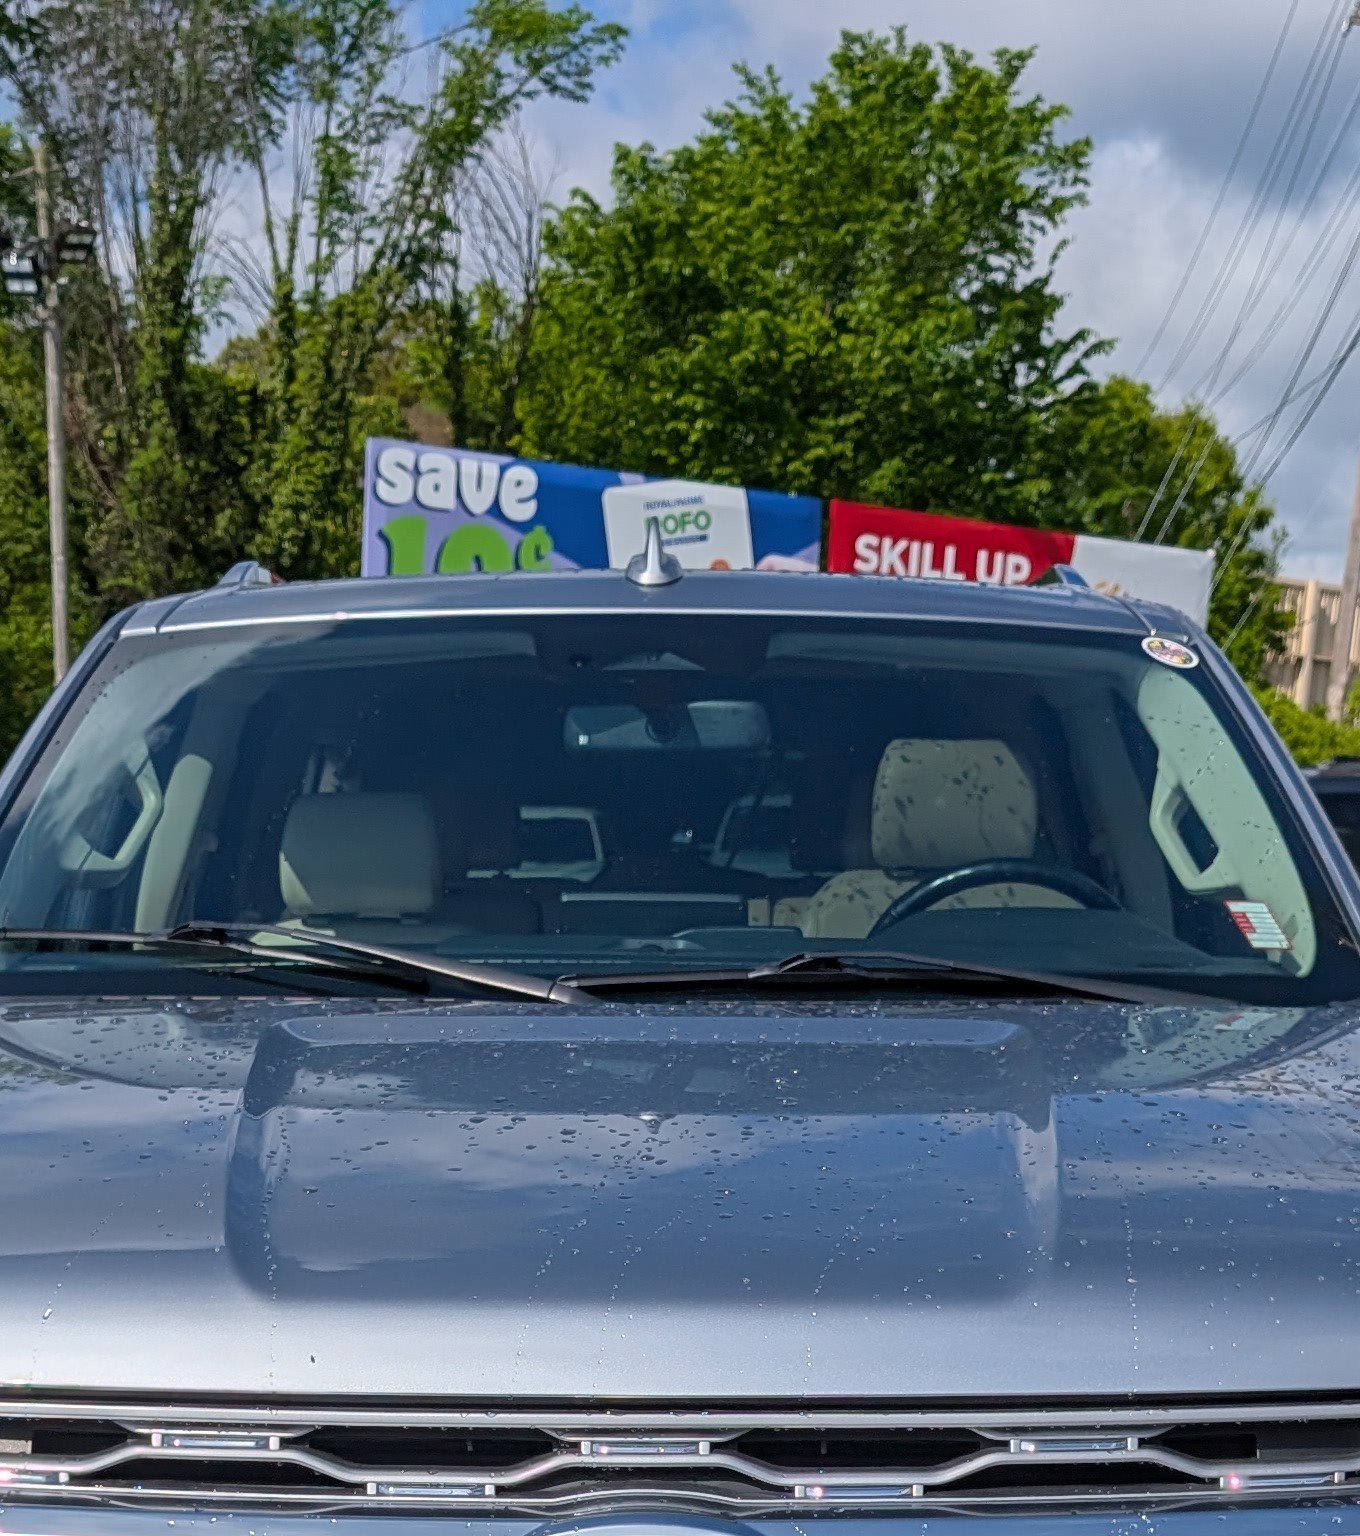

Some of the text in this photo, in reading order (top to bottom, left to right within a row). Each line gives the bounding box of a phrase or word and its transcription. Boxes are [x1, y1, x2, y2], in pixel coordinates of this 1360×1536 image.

[374, 447, 539, 522] save
[645, 510, 712, 534] OFO
[853, 533, 1032, 585] SKILL UP
